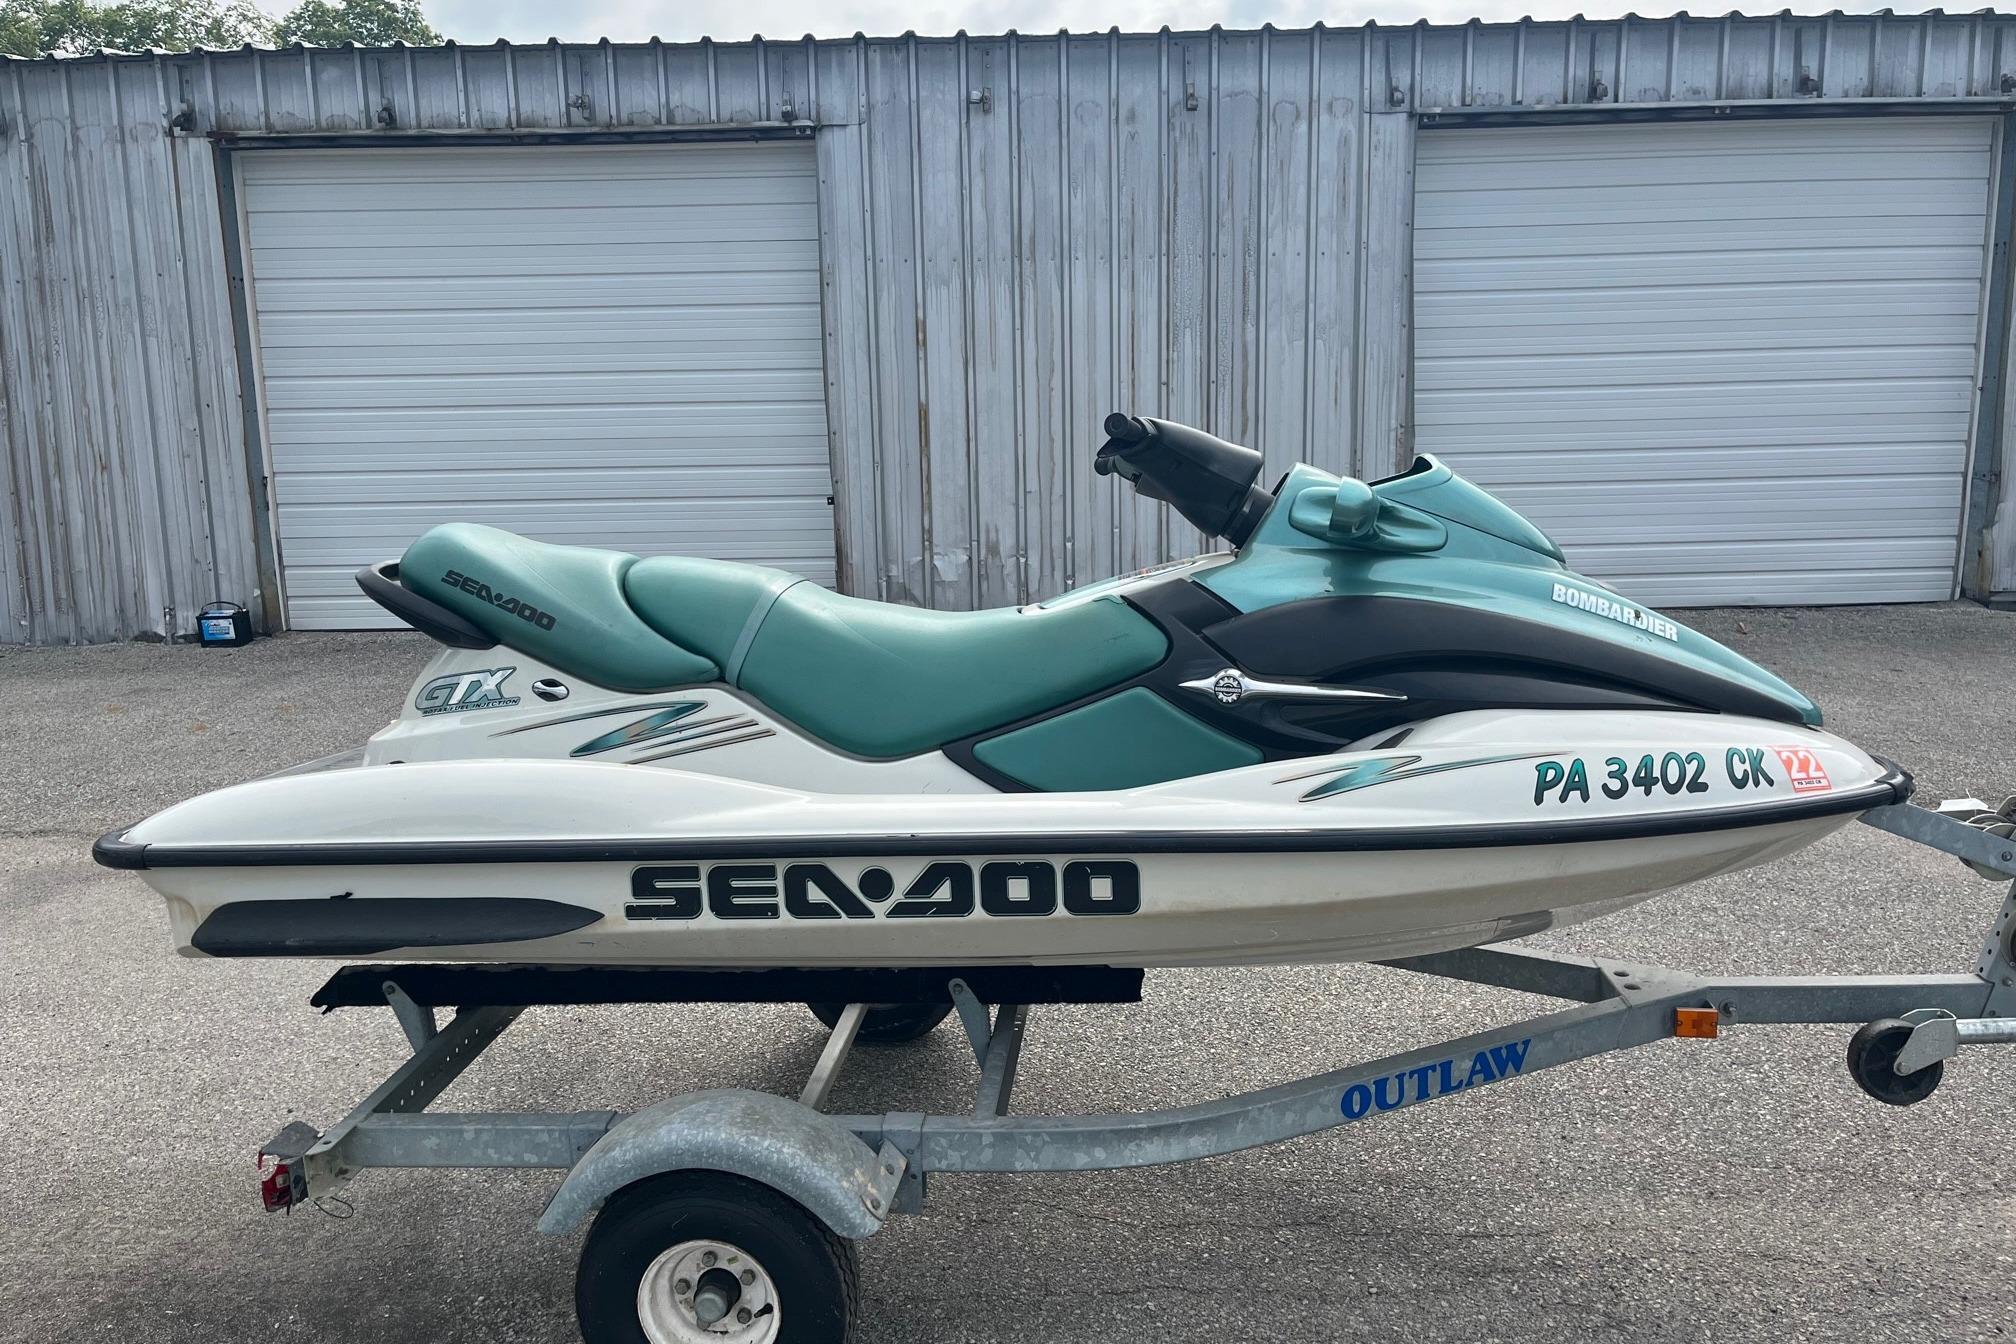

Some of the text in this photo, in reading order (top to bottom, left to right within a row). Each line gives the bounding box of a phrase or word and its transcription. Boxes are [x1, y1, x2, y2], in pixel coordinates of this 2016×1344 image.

[1551, 583, 1679, 642] BOMBARDIER
[415, 666, 517, 709] GTX
[472, 699, 518, 708] INJECTION
[1534, 747, 1774, 806] PA 3402 CK
[1780, 750, 1825, 779] 22
[1340, 1038, 1532, 1120] OUTLAW
